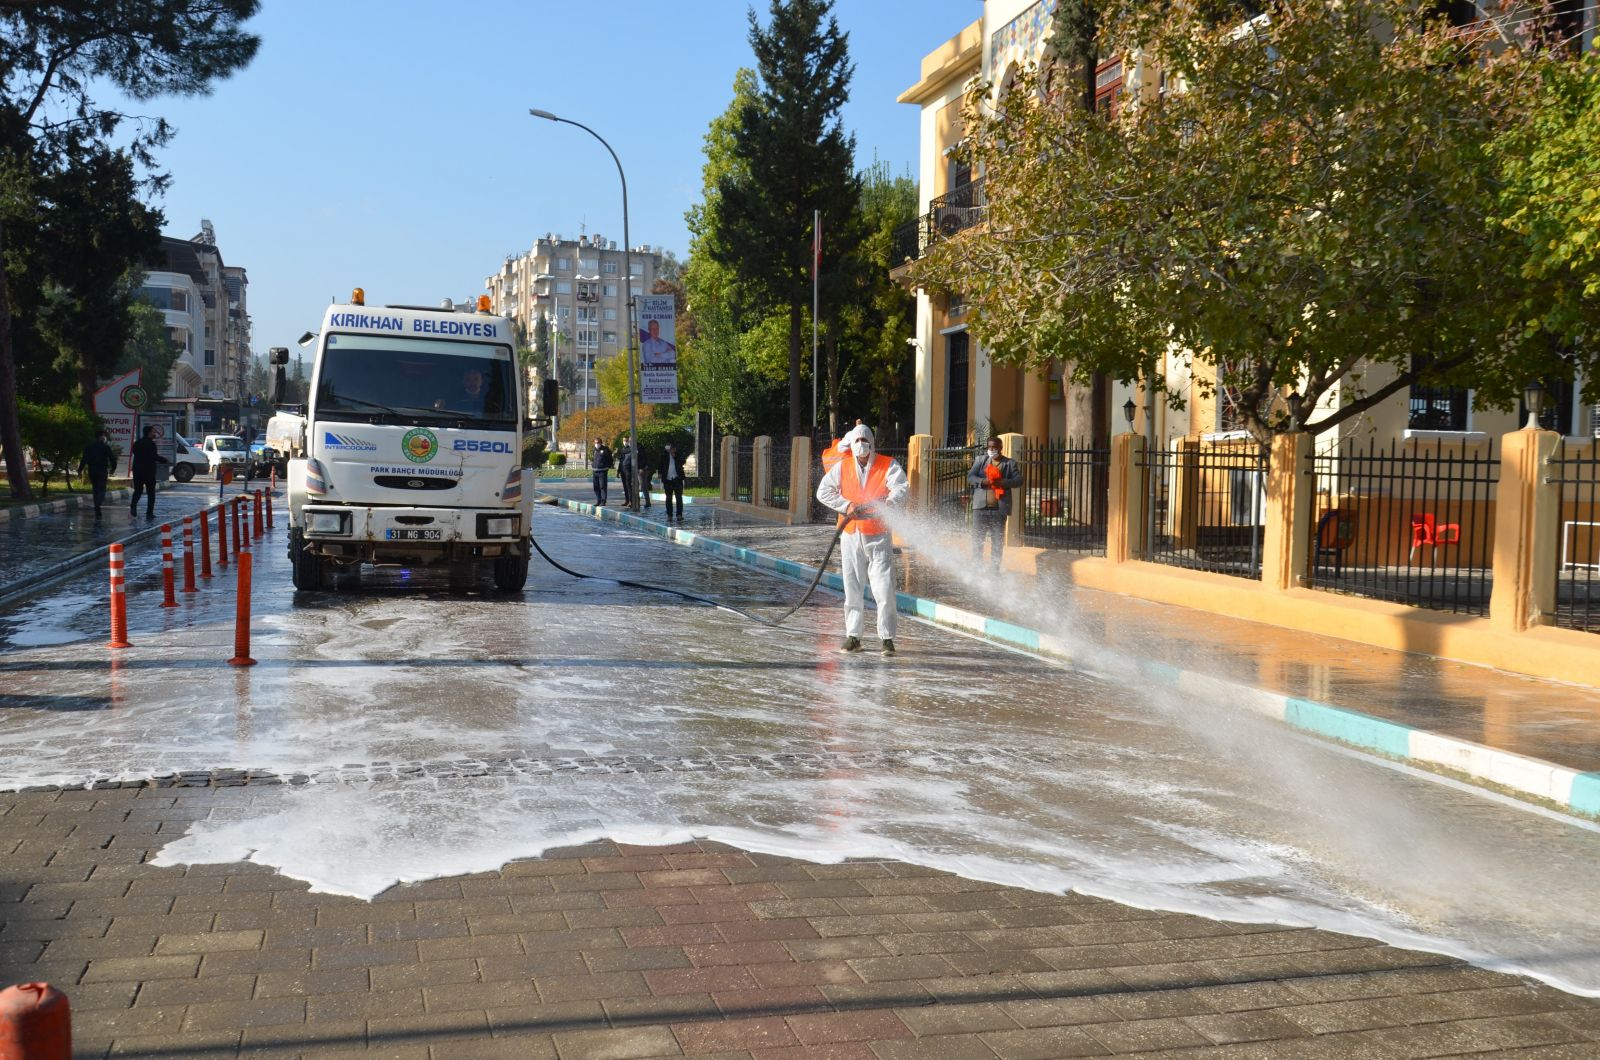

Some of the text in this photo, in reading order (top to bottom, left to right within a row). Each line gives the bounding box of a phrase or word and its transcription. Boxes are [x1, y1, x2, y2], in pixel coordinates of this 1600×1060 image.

[330, 313, 403, 331] KIRIKHAN
[453, 439, 514, 454] 2520L
[391, 467, 416, 475] BAHÇE
[391, 530, 440, 539] 31 NG 904
